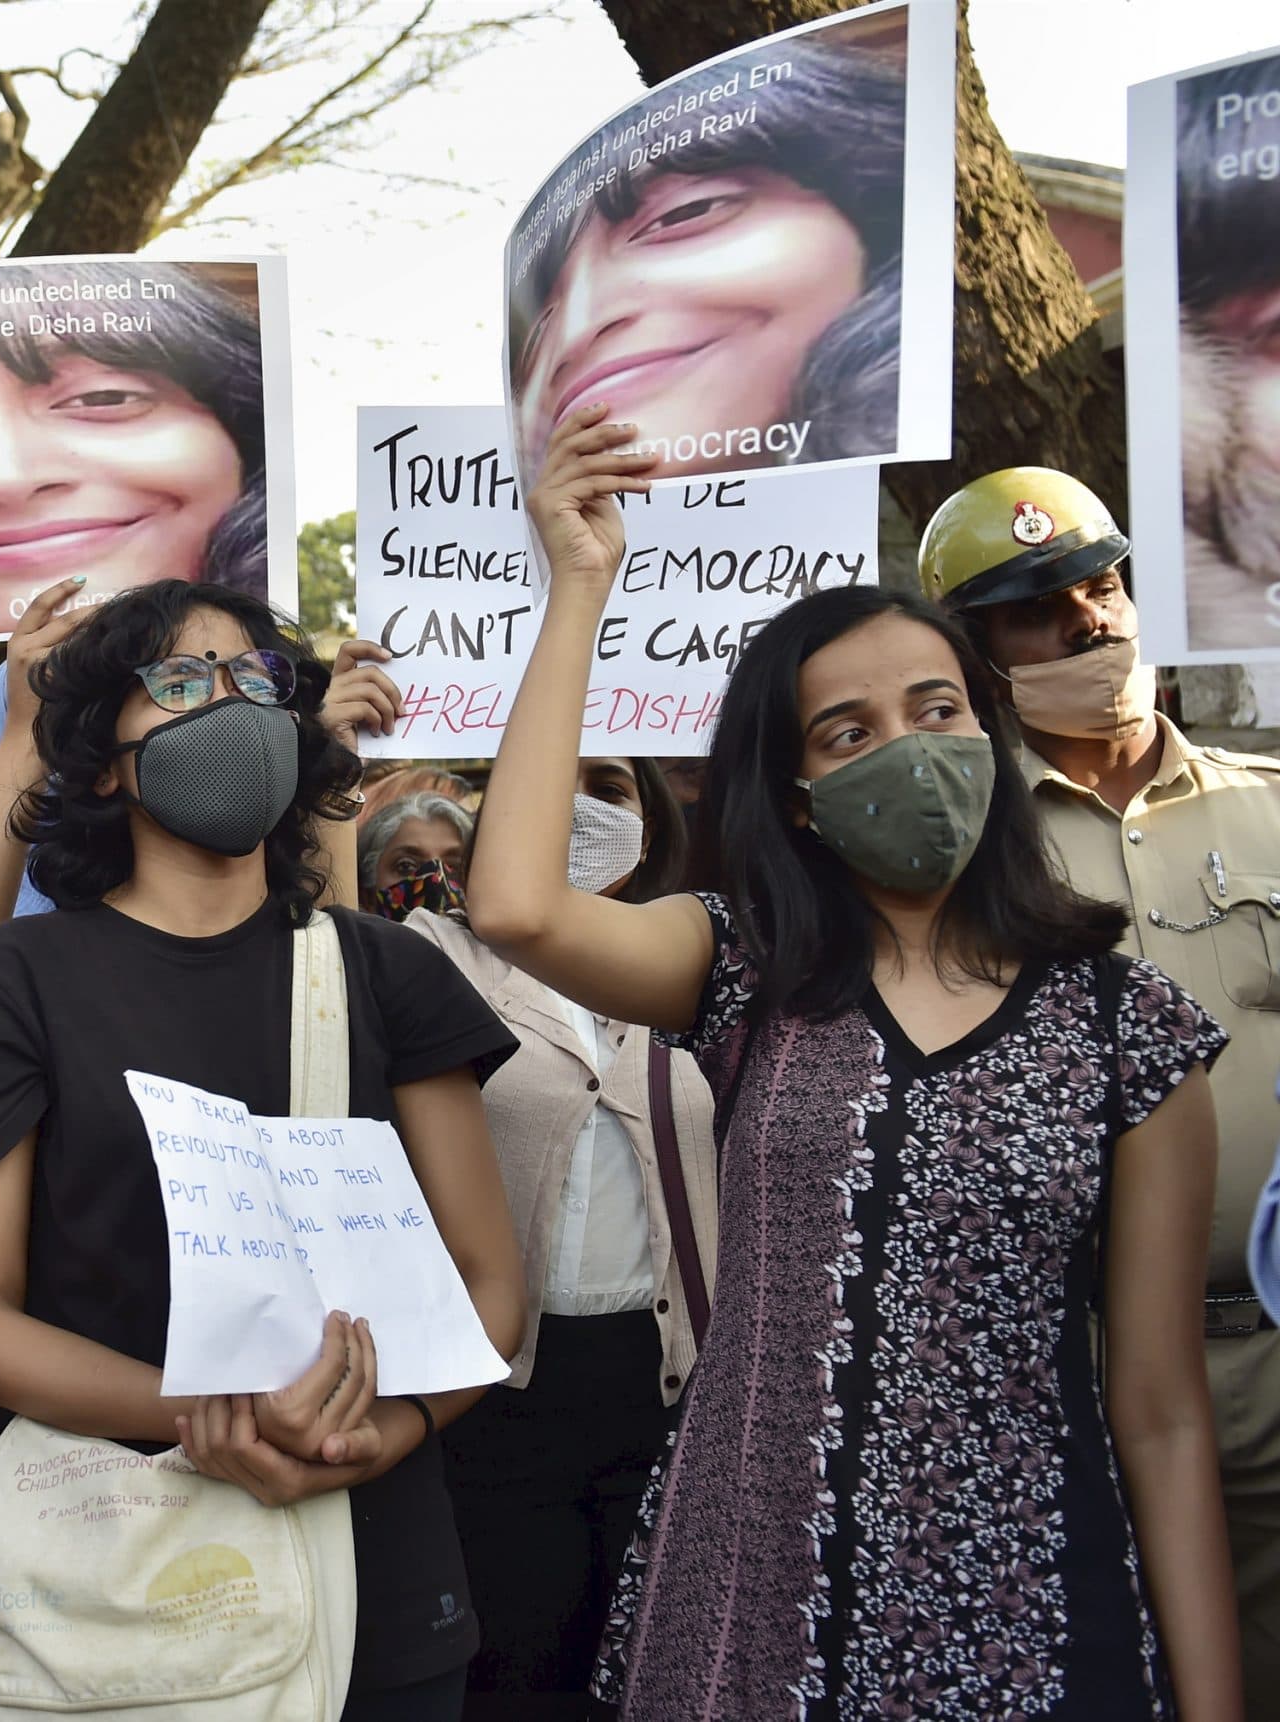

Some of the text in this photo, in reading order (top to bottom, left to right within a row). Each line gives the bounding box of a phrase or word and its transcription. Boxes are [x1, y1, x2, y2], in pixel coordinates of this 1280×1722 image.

[516, 61, 793, 256] Protest against undeclared Em
[555, 166, 618, 229] Release
[628, 129, 692, 172] Disha
[699, 100, 758, 140] Ravi
[0, 278, 131, 305] undeclared
[140, 279, 176, 300] Em
[28, 313, 96, 336] Disha
[103, 312, 152, 333] Ravi
[616, 420, 812, 463] mocracy
[373, 424, 518, 511] TRUTH
[619, 545, 865, 599] EMOCRACY
[380, 605, 531, 661] CAN'T
[645, 617, 770, 675] CAGE
[136, 1081, 174, 1103] YOU
[191, 1096, 246, 1127] TEACH
[288, 1128, 345, 1147] ABOUT
[156, 1131, 383, 1187] REVOLUTION AND THEN
[168, 1179, 208, 1206] PUT
[228, 1191, 255, 1212] US
[288, 1215, 324, 1234] JAIL
[337, 1213, 388, 1232] WHEN
[394, 1207, 425, 1228] WE
[174, 1231, 232, 1257] TALK
[242, 1239, 288, 1259] ABOUT
[14, 1450, 83, 1476] ADVOCACY
[16, 1475, 59, 1492] CHILD
[62, 1456, 154, 1484] PROTECTION
[57, 1507, 80, 1519] AND
[160, 1496, 190, 1508] 2012
[83, 1508, 132, 1525] MUMBAI
